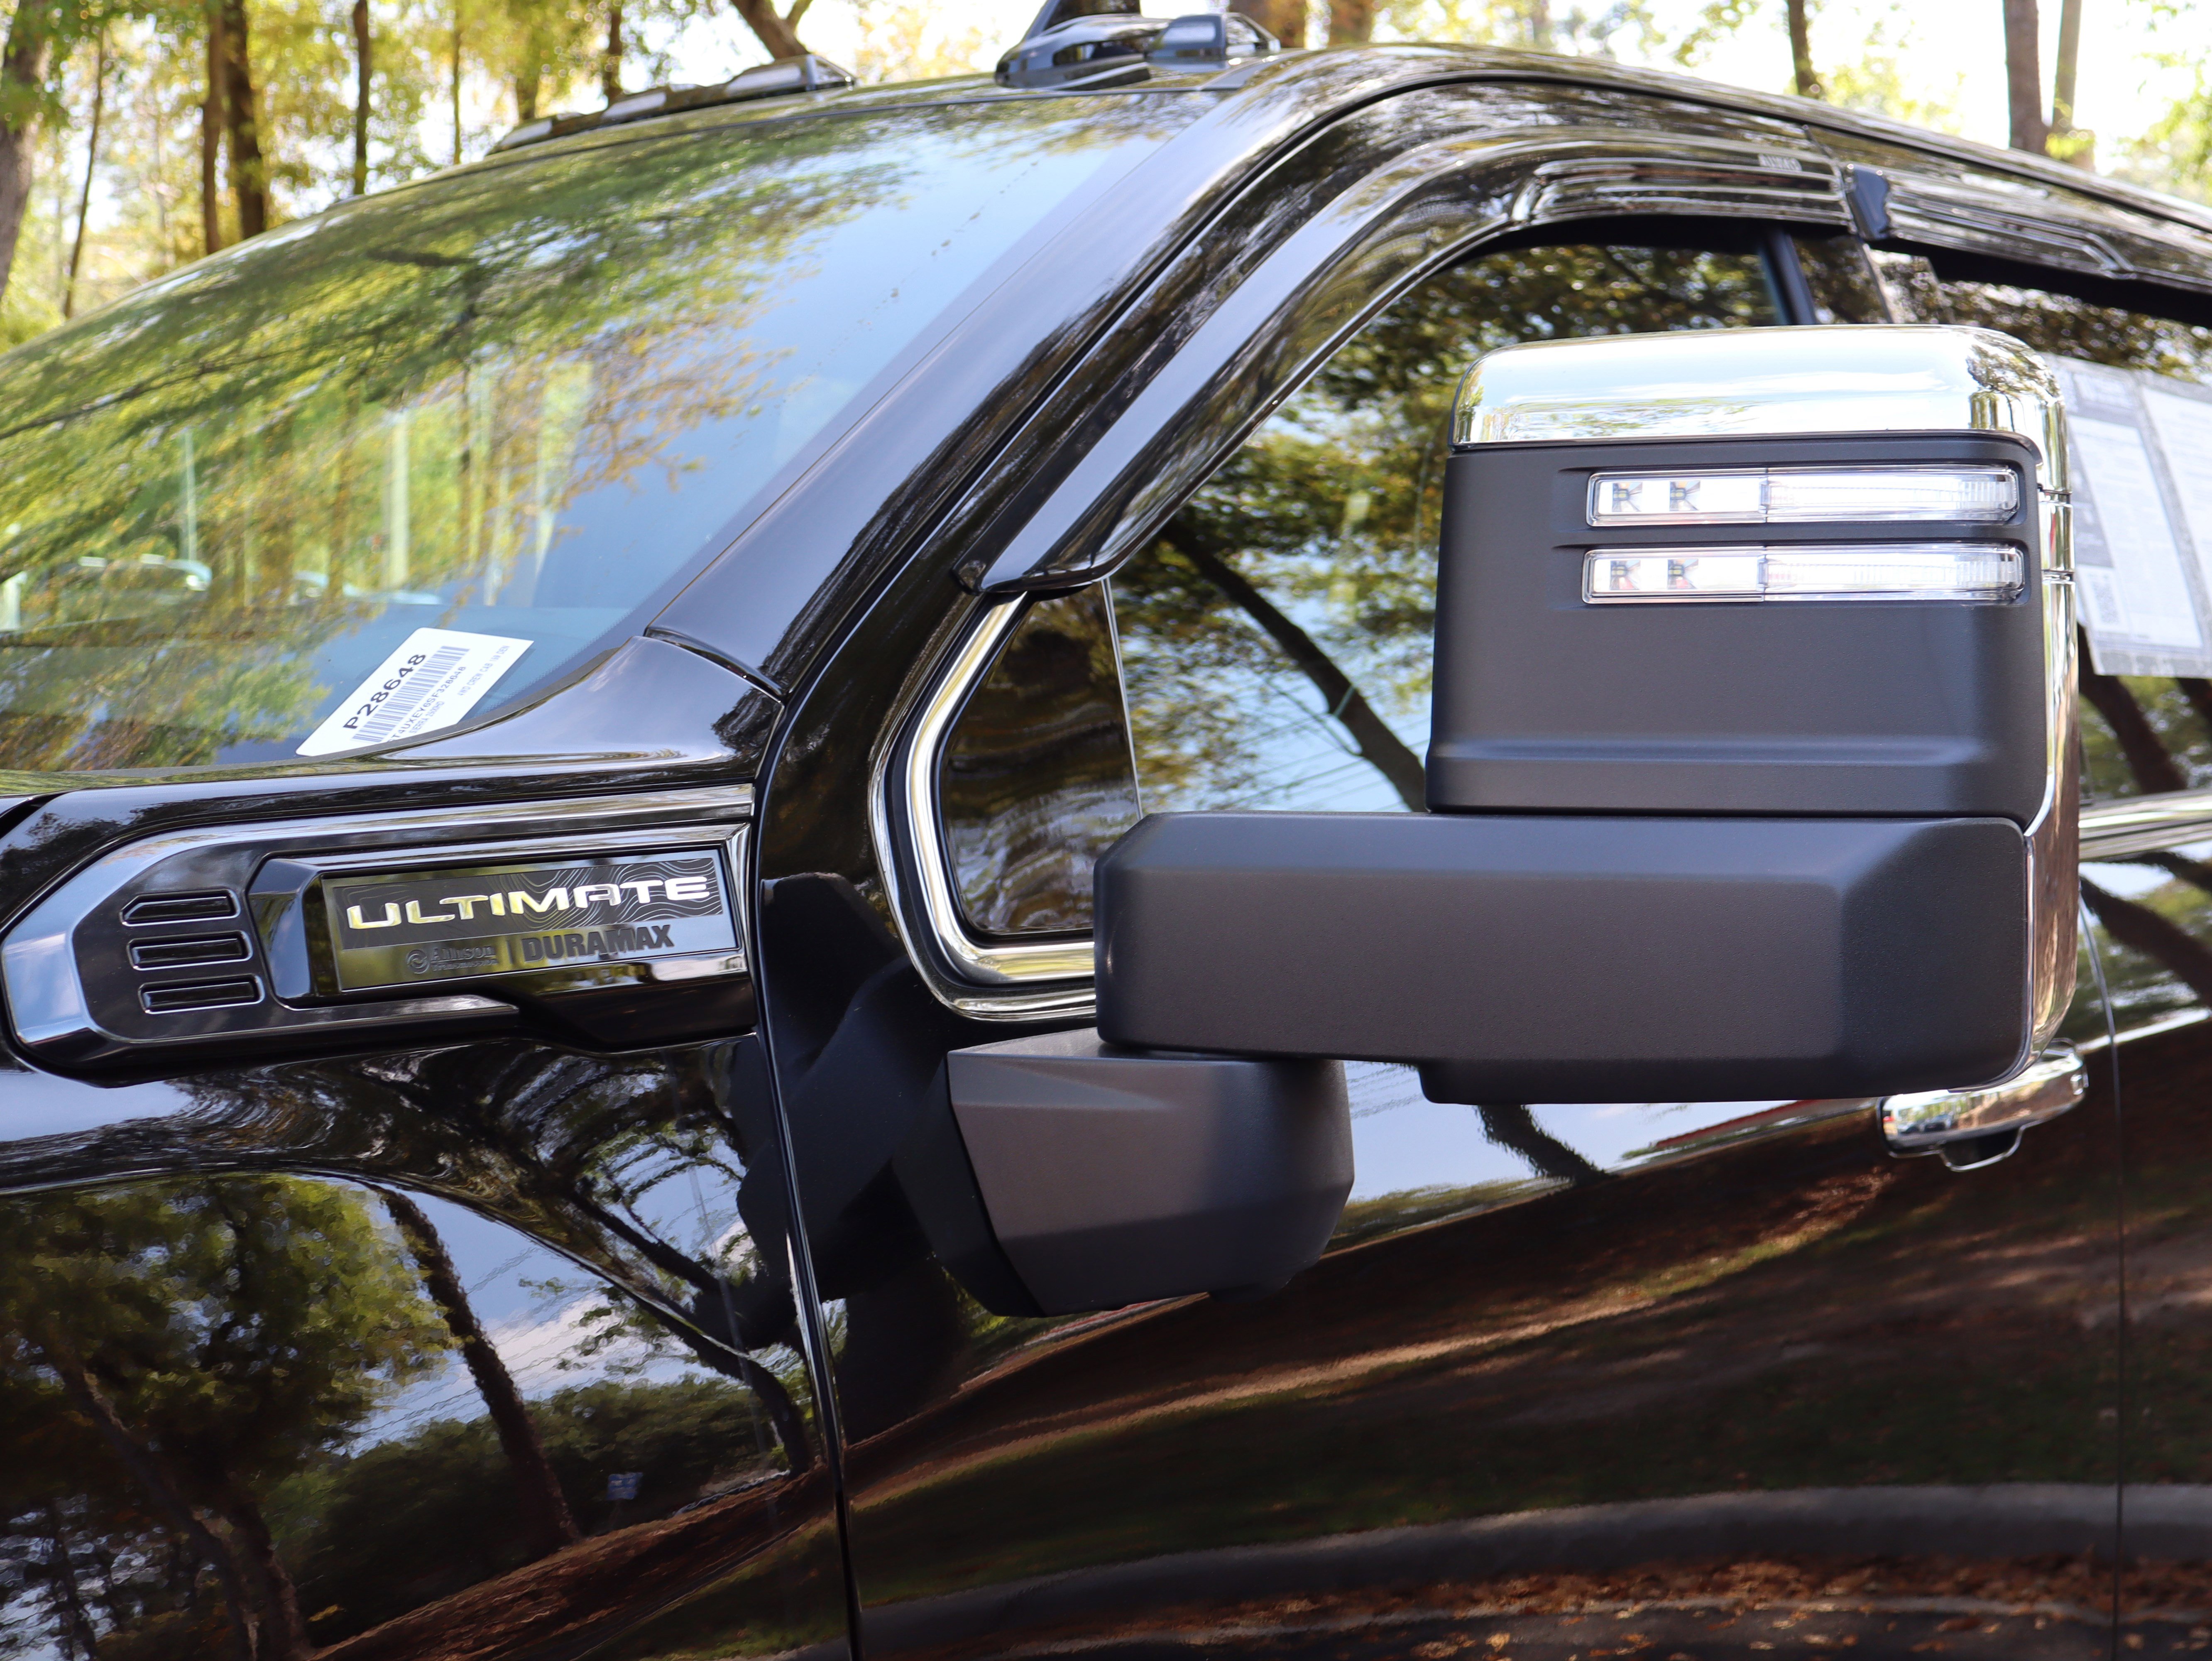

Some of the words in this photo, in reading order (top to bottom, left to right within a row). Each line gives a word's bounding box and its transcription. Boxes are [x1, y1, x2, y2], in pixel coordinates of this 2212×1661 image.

[343, 654, 426, 729] P28648
[467, 673, 483, 686] CREW
[480, 663, 493, 672] CAB
[409, 718, 429, 733] SIERRA
[425, 701, 444, 717] 2500HD
[347, 876, 710, 929] ULTIMATE
[522, 924, 674, 962] DURAMAX
